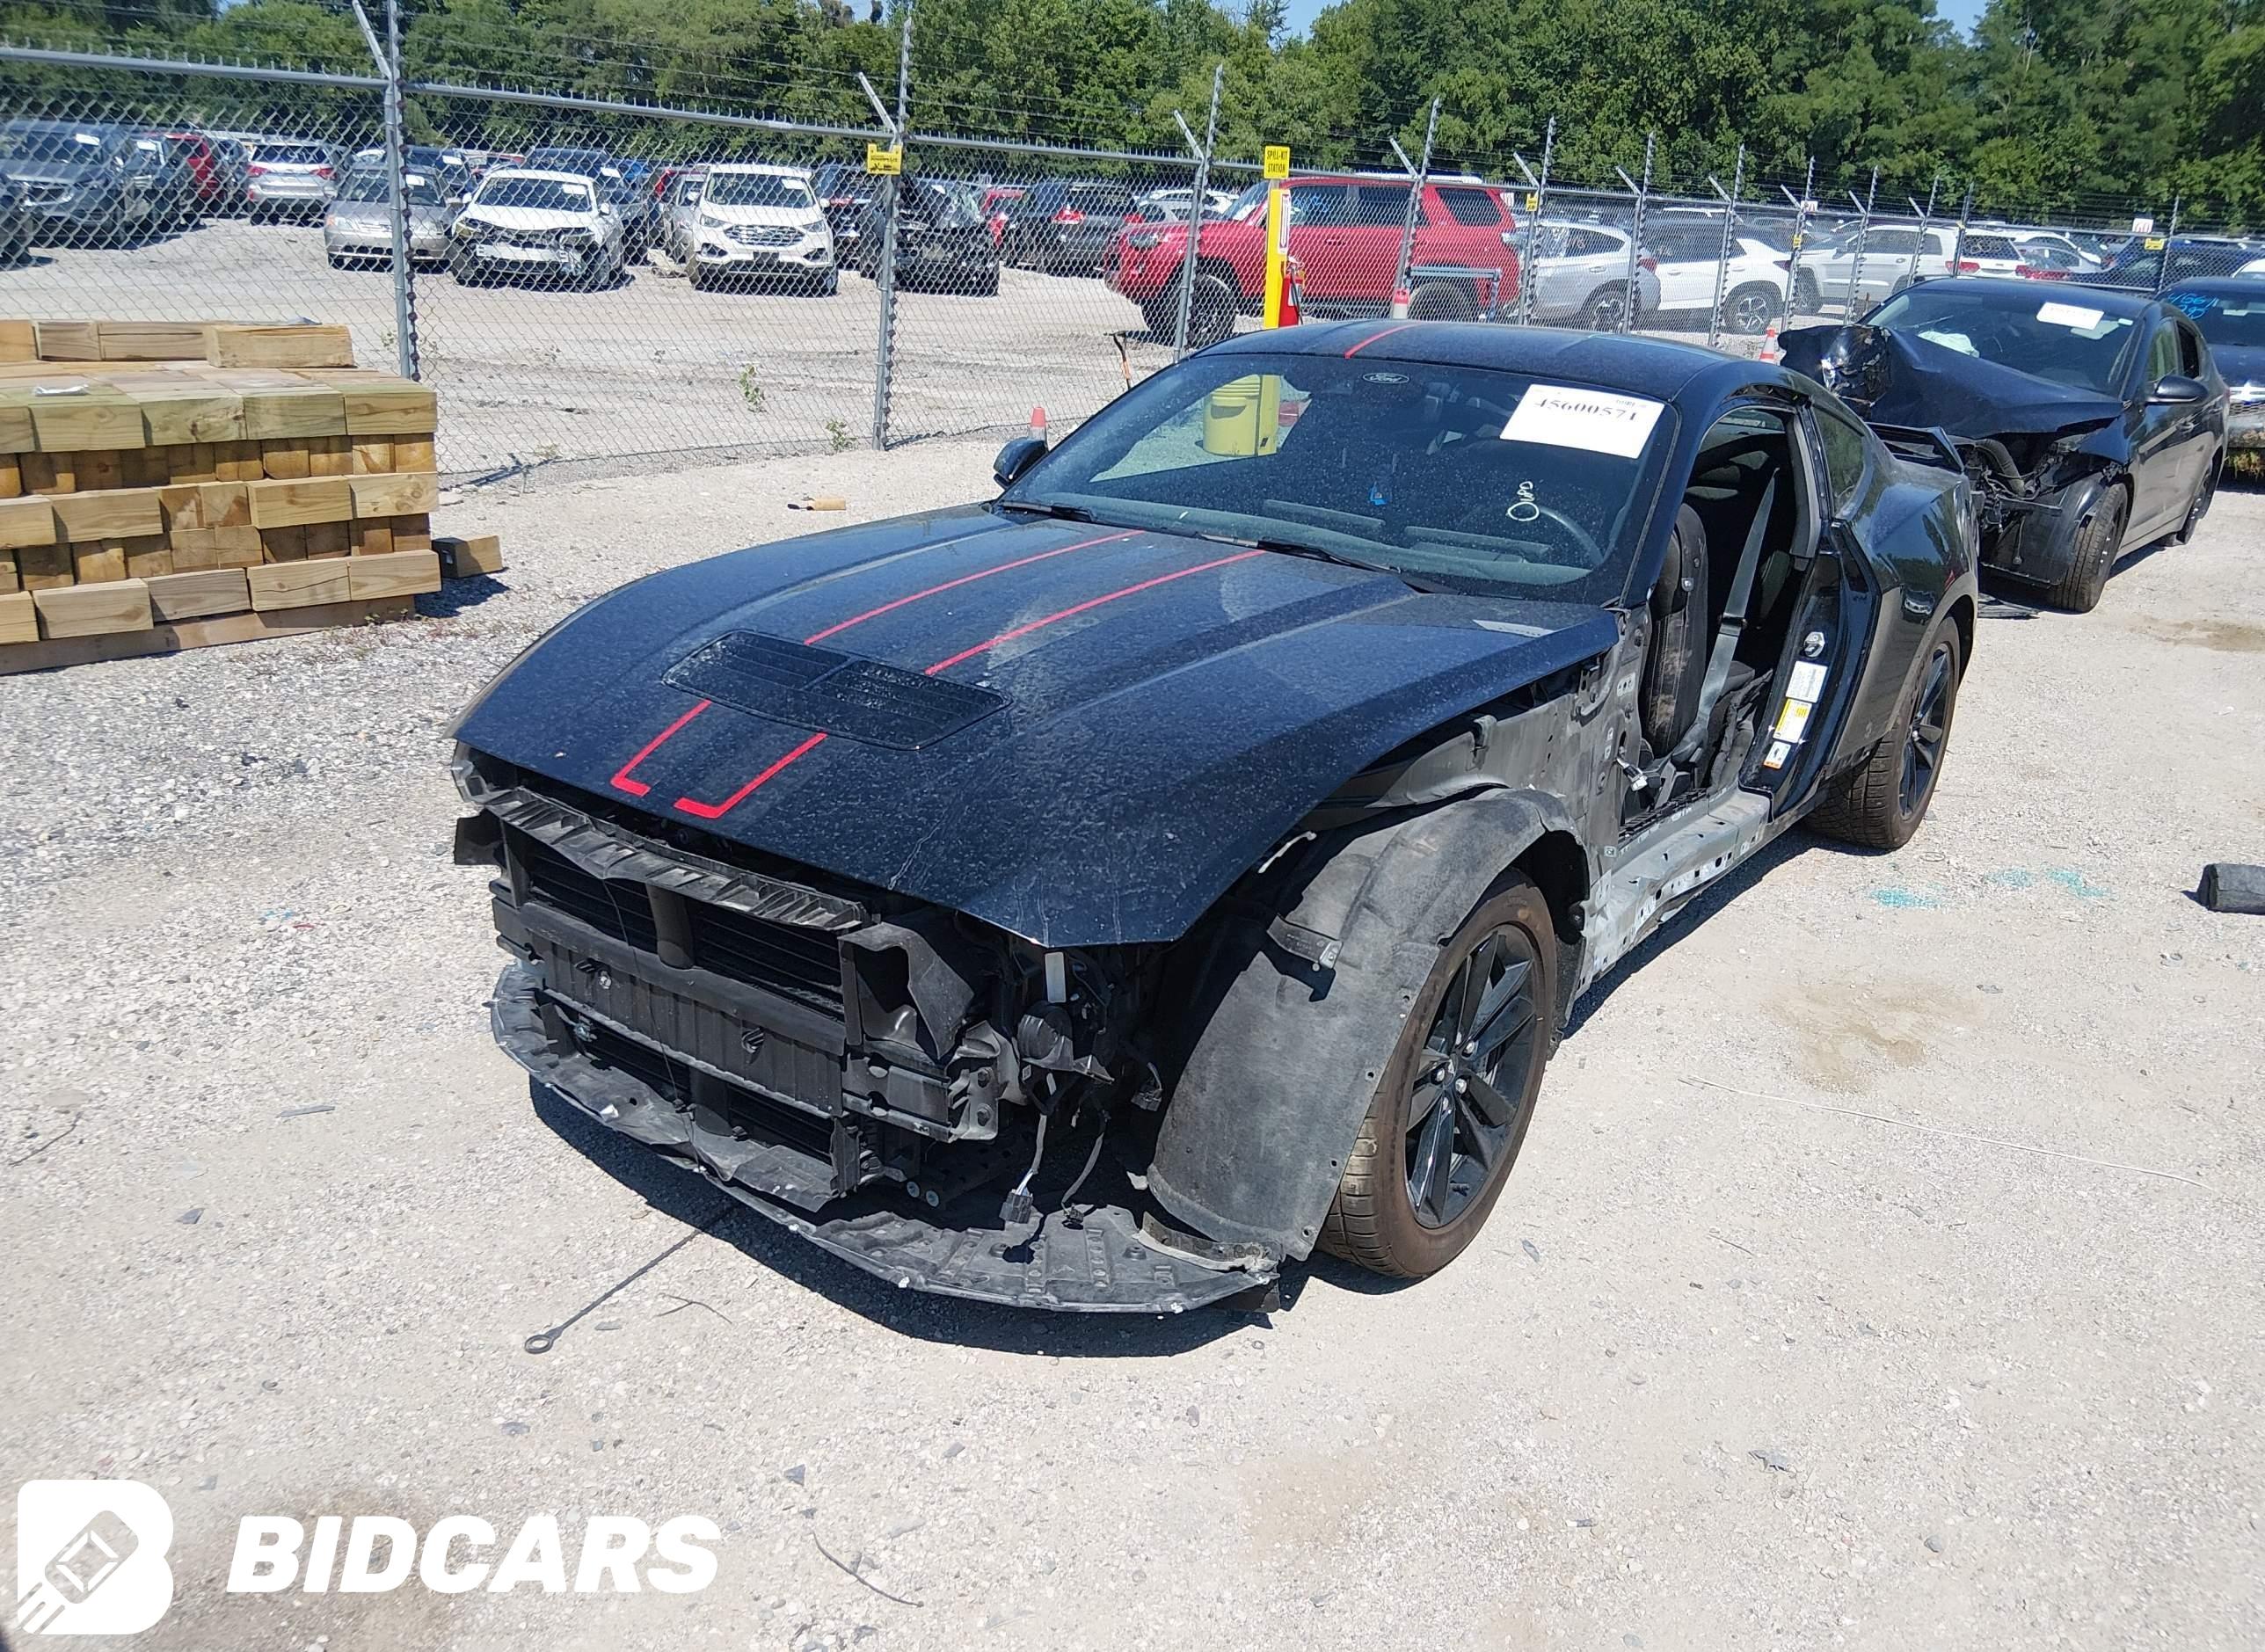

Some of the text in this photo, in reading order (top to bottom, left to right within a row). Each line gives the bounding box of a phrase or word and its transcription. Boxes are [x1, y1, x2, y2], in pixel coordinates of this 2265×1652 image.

[1267, 149, 1288, 160] SPILL-KIT
[1268, 163, 1285, 173] STATION
[1367, 373, 1405, 383] Ford
[1534, 397, 1638, 421] 45600571
